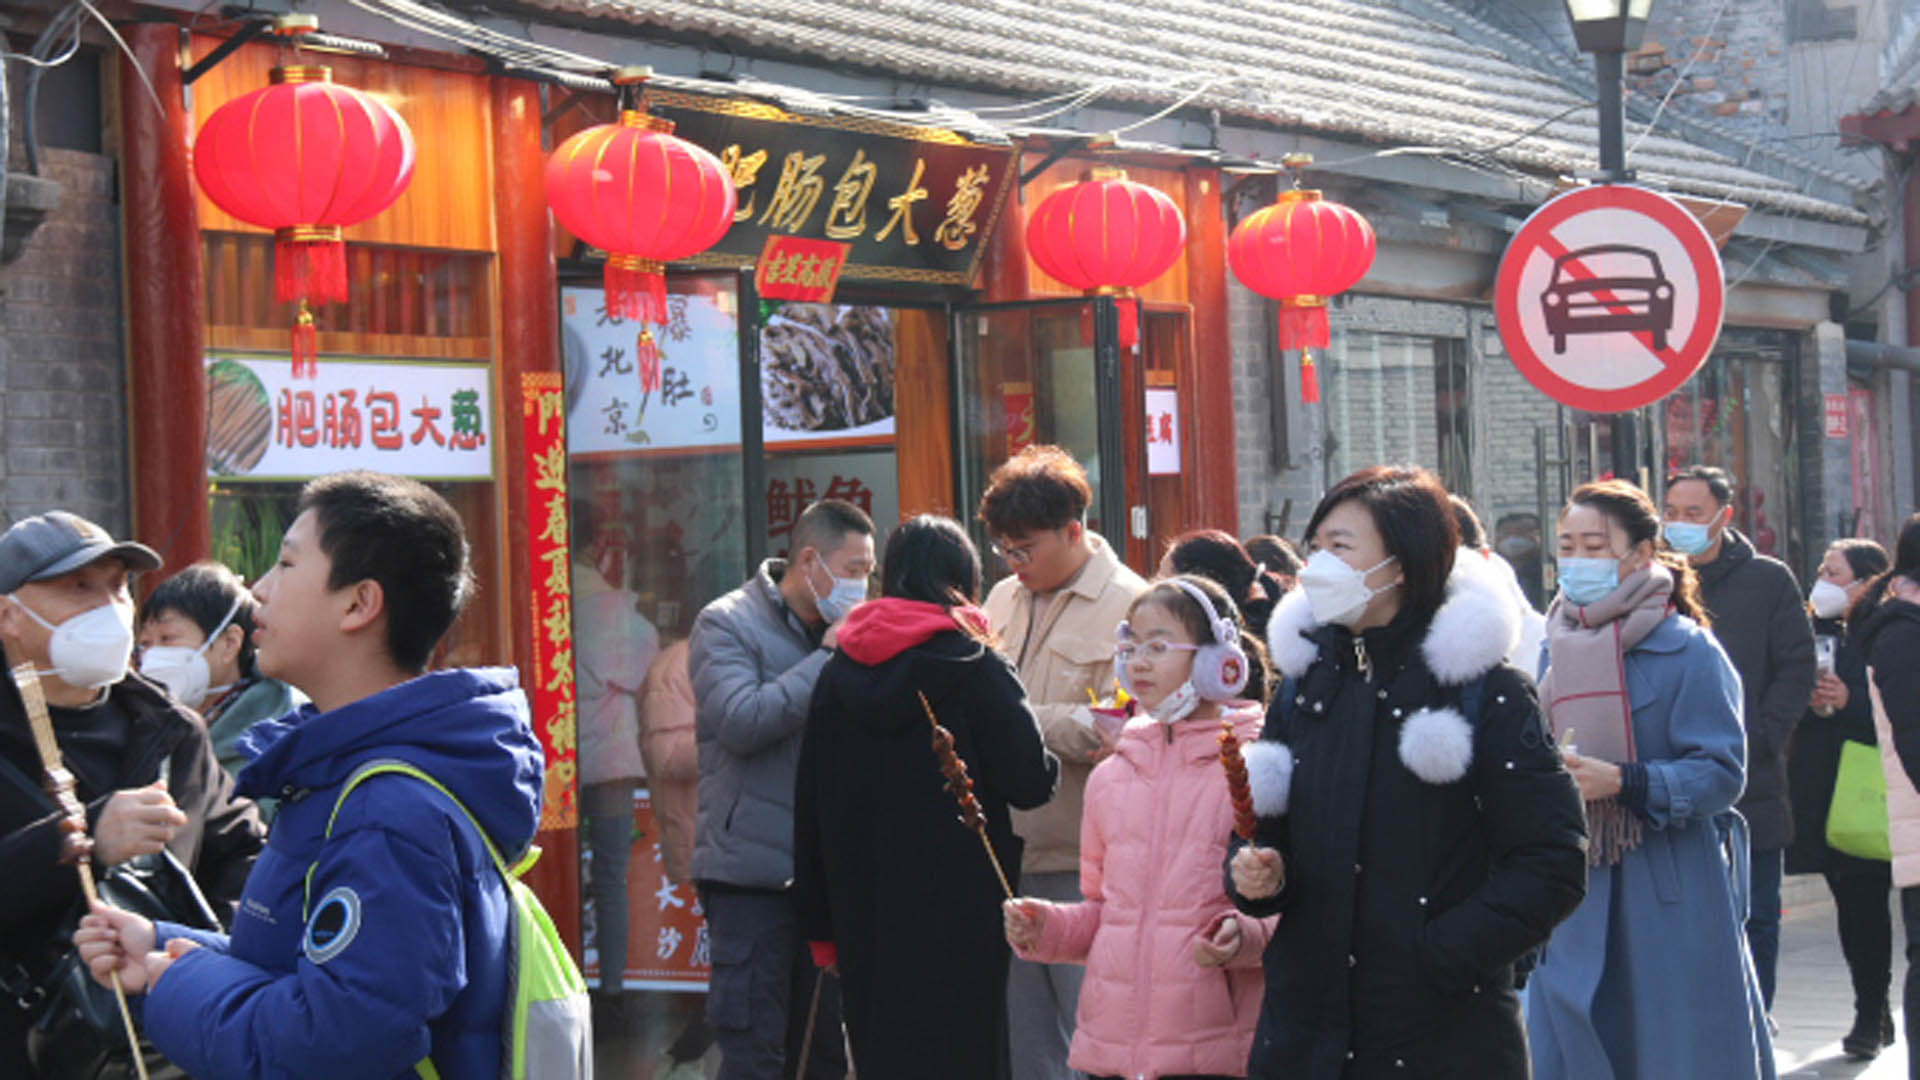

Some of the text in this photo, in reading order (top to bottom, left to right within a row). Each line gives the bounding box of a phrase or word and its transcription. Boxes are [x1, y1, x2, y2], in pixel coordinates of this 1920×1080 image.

[277, 386, 486, 450] 肥肠包大葱
